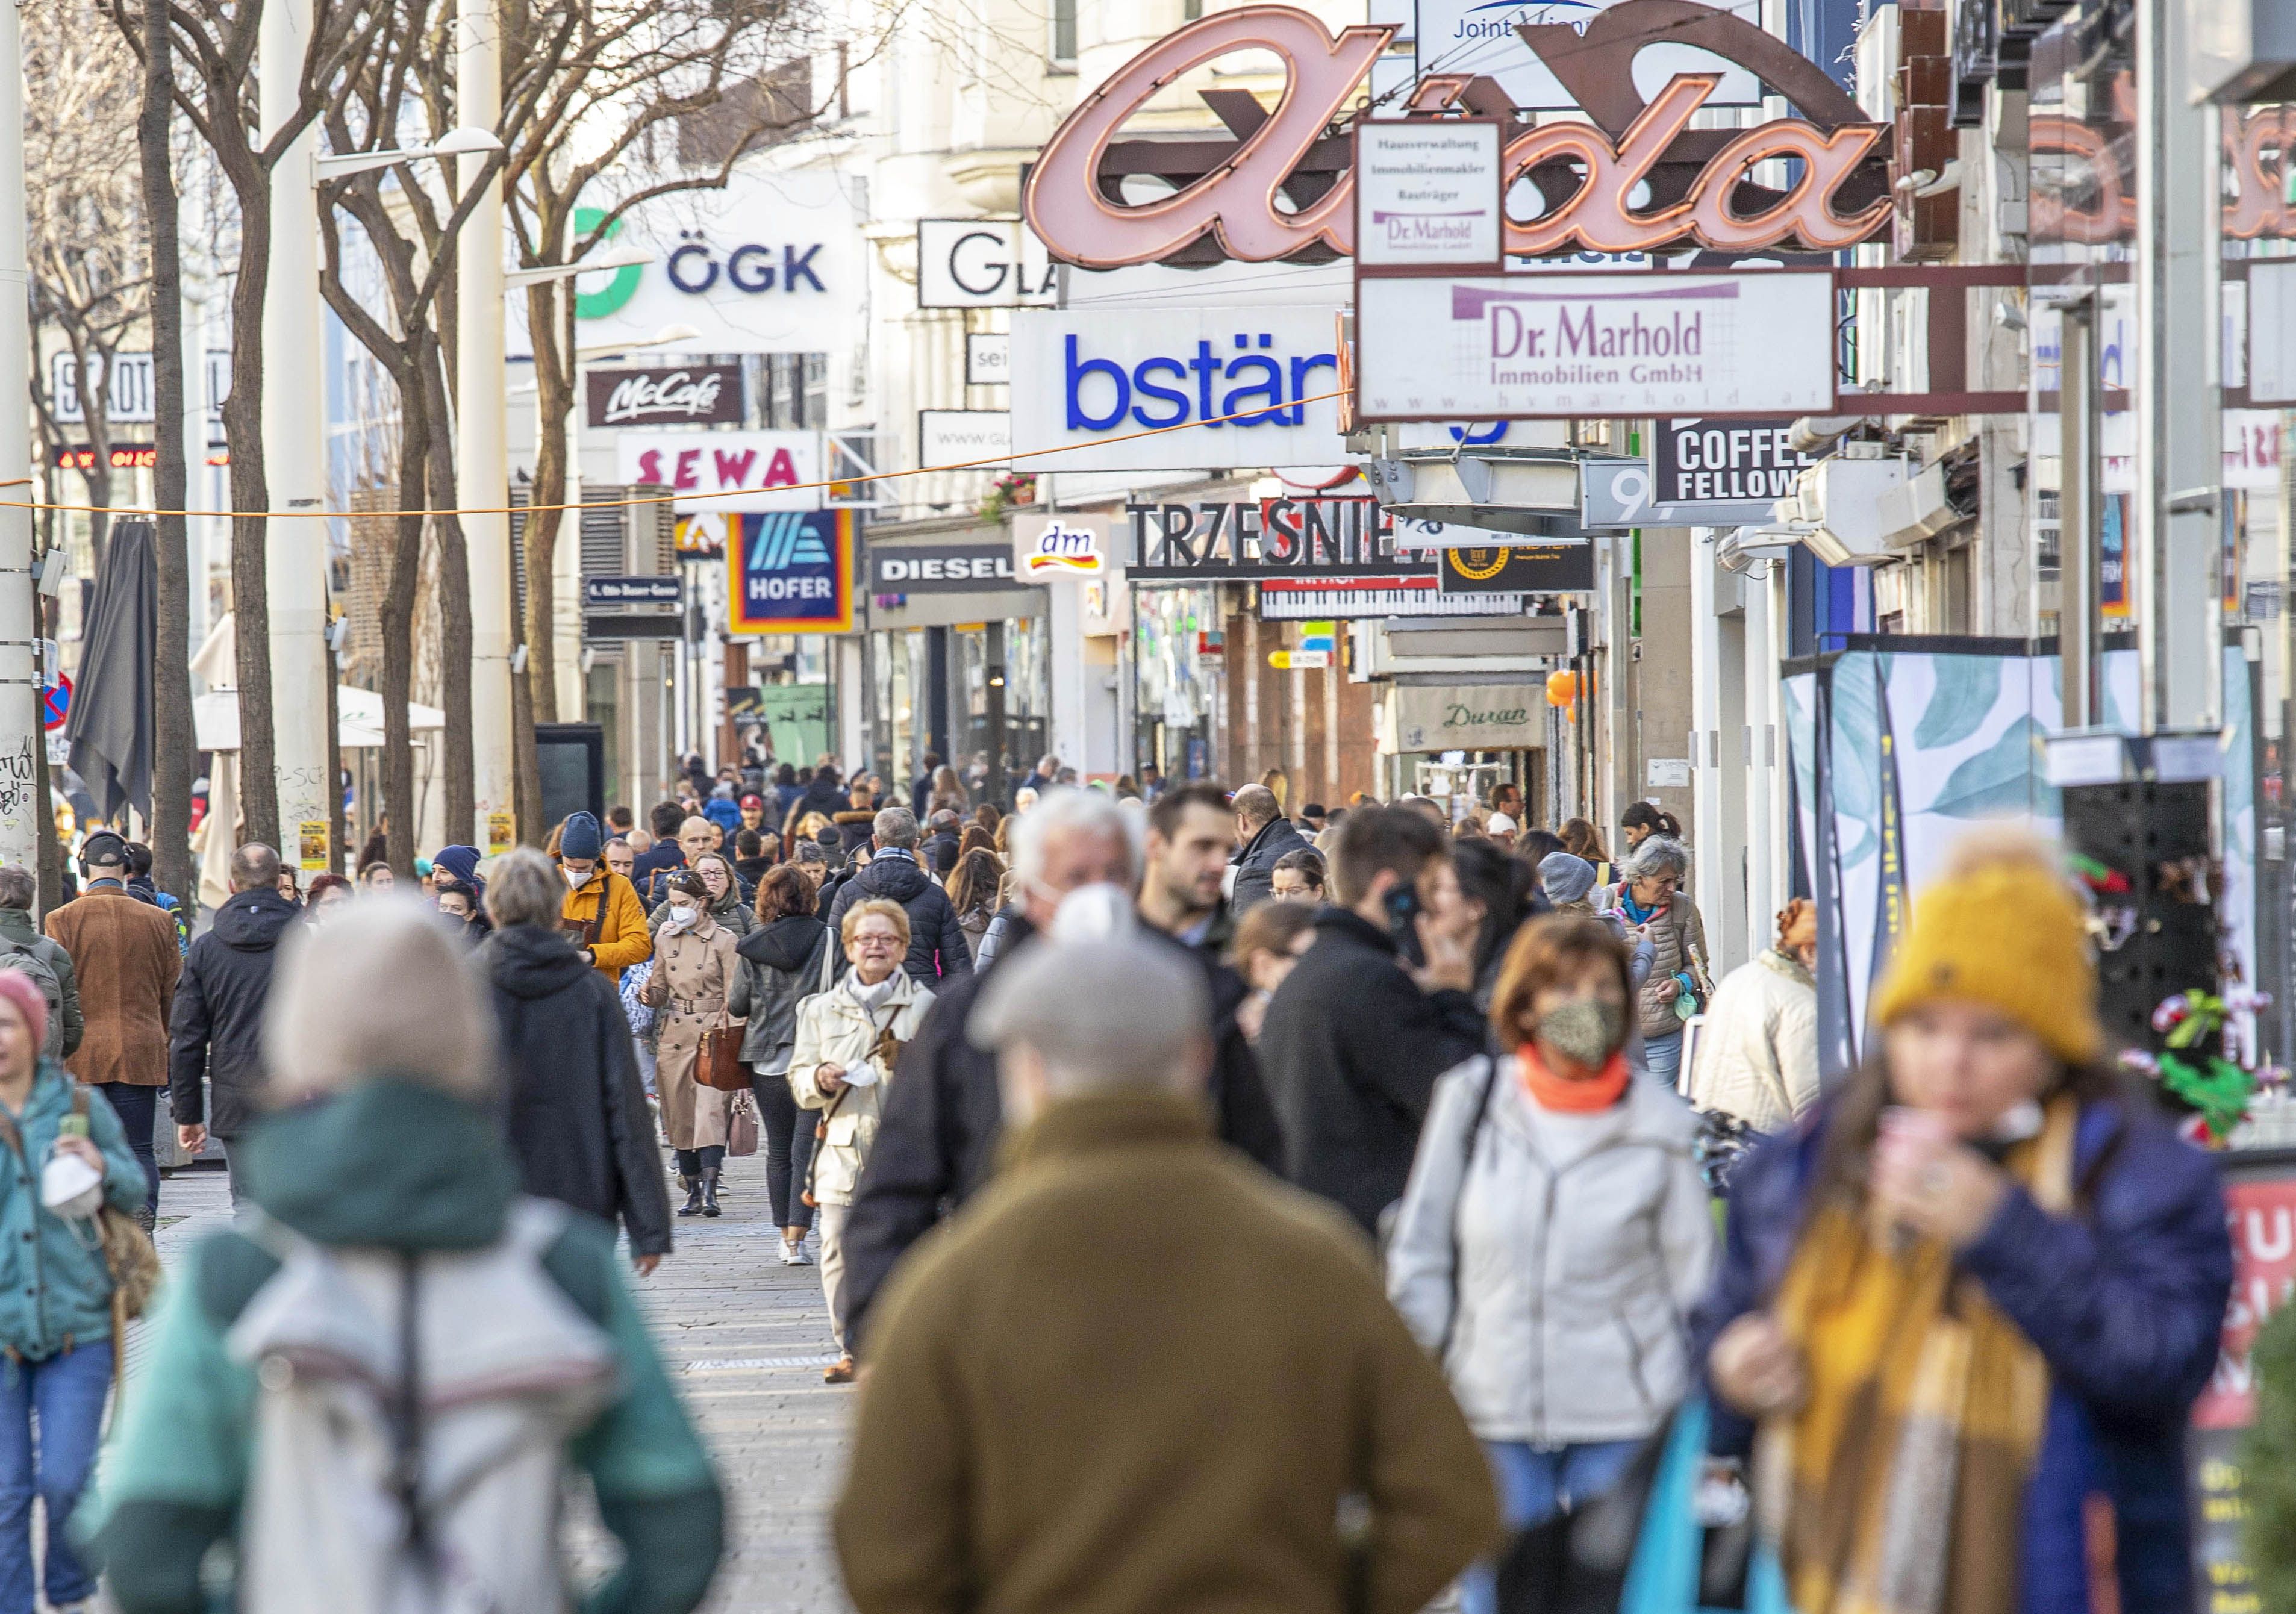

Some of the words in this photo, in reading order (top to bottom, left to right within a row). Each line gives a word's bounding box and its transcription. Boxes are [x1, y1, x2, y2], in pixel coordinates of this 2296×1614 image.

[1454, 18, 1513, 38] Joint
[1021, 5, 1894, 266] Ada
[1377, 138, 1480, 152] Hausverwaltung
[1371, 163, 1485, 175] Immobilienmakler
[1398, 190, 1459, 202] Bauträger
[1414, 217, 1471, 240] Marhold
[668, 229, 826, 294] ÖGK
[1555, 304, 1702, 358] Marhold
[1491, 361, 1619, 385] Immobilien
[1630, 364, 1703, 384] GmbH
[637, 447, 799, 491] SEWA
[1042, 526, 1091, 553] dm
[881, 557, 1015, 581] DIESEL
[749, 576, 832, 600] HOFER
